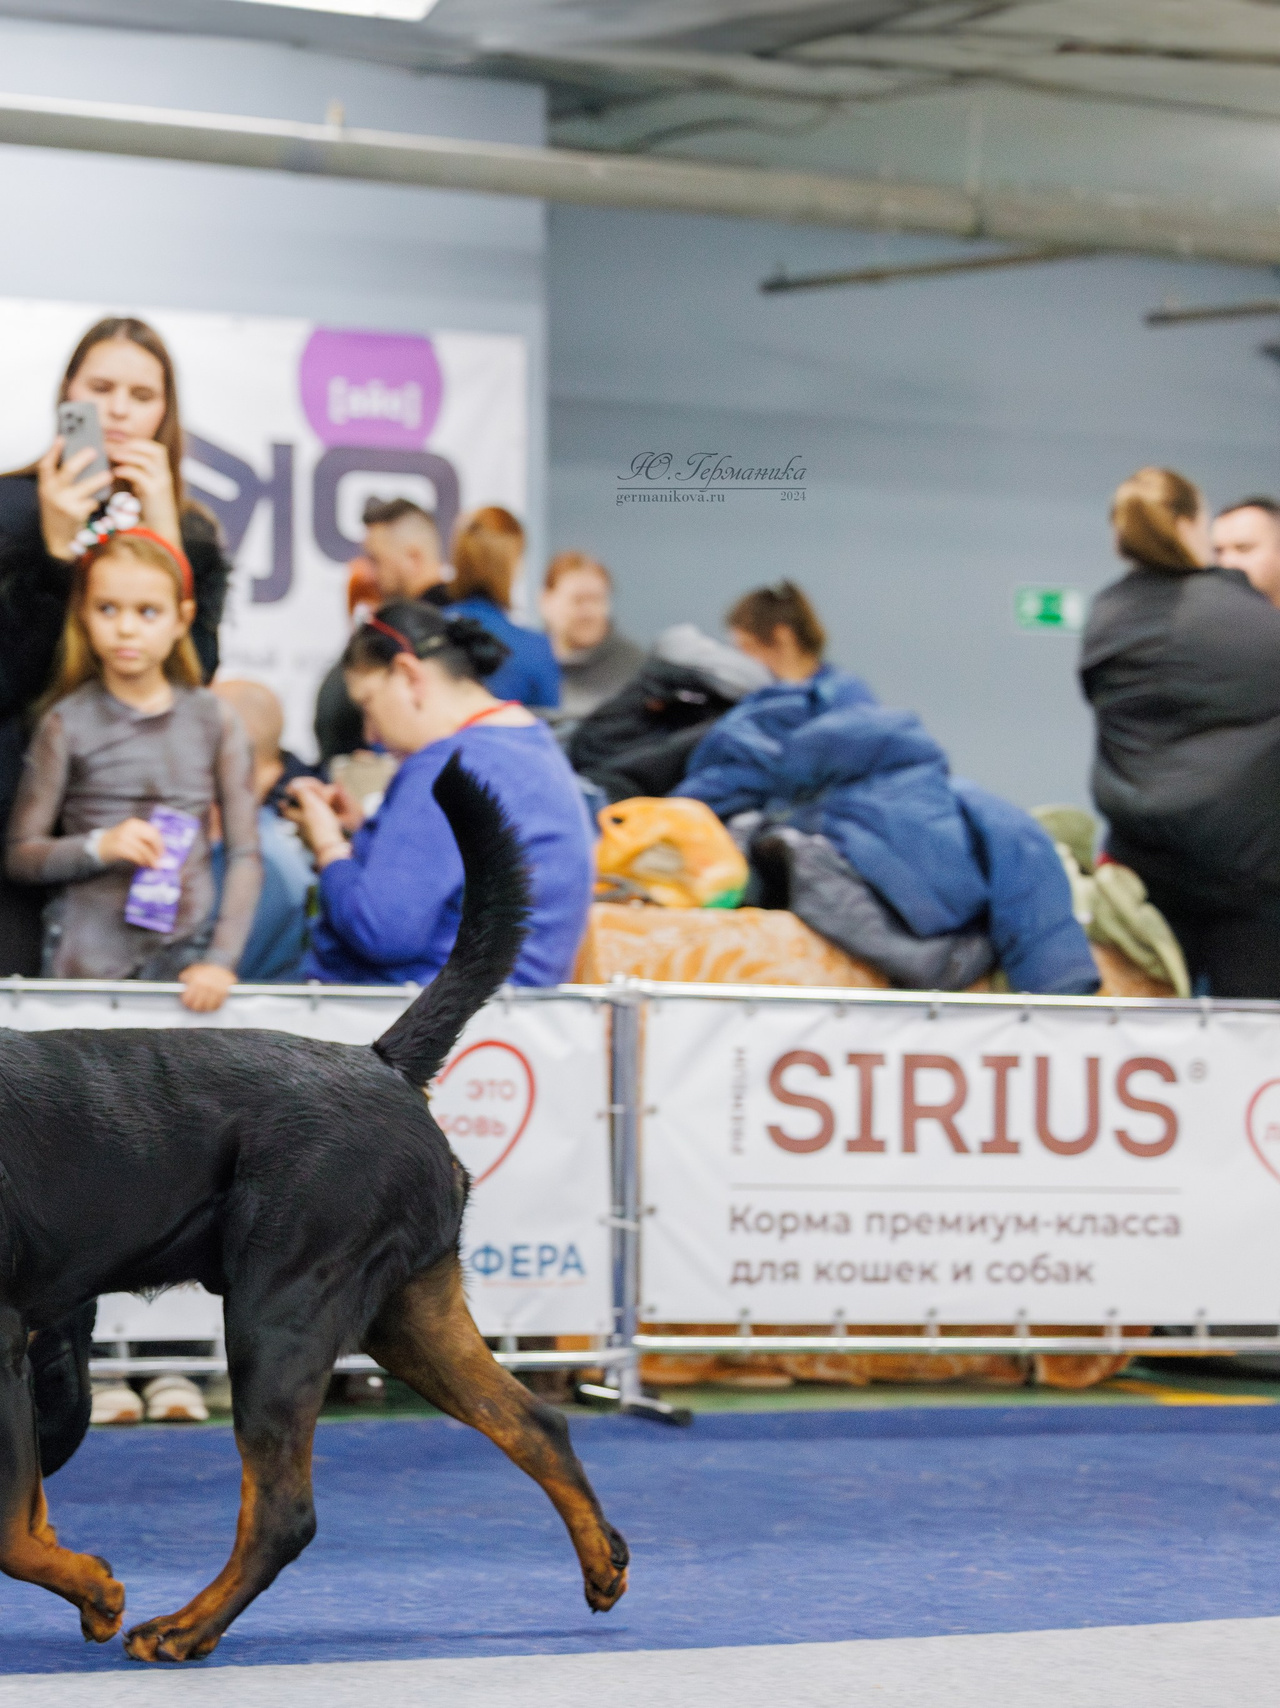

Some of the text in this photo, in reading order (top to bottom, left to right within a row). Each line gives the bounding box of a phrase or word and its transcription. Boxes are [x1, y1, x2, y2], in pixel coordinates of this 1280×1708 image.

[467, 1079, 516, 1101] ЭТО
[766, 1048, 1180, 1158] SIRIUS
[436, 1114, 507, 1138] БОВЬ
[729, 1204, 1182, 1244] Корма премиум-класса
[470, 1241, 585, 1278] ФЕРА
[730, 1252, 1095, 1287] для кошек и собак
